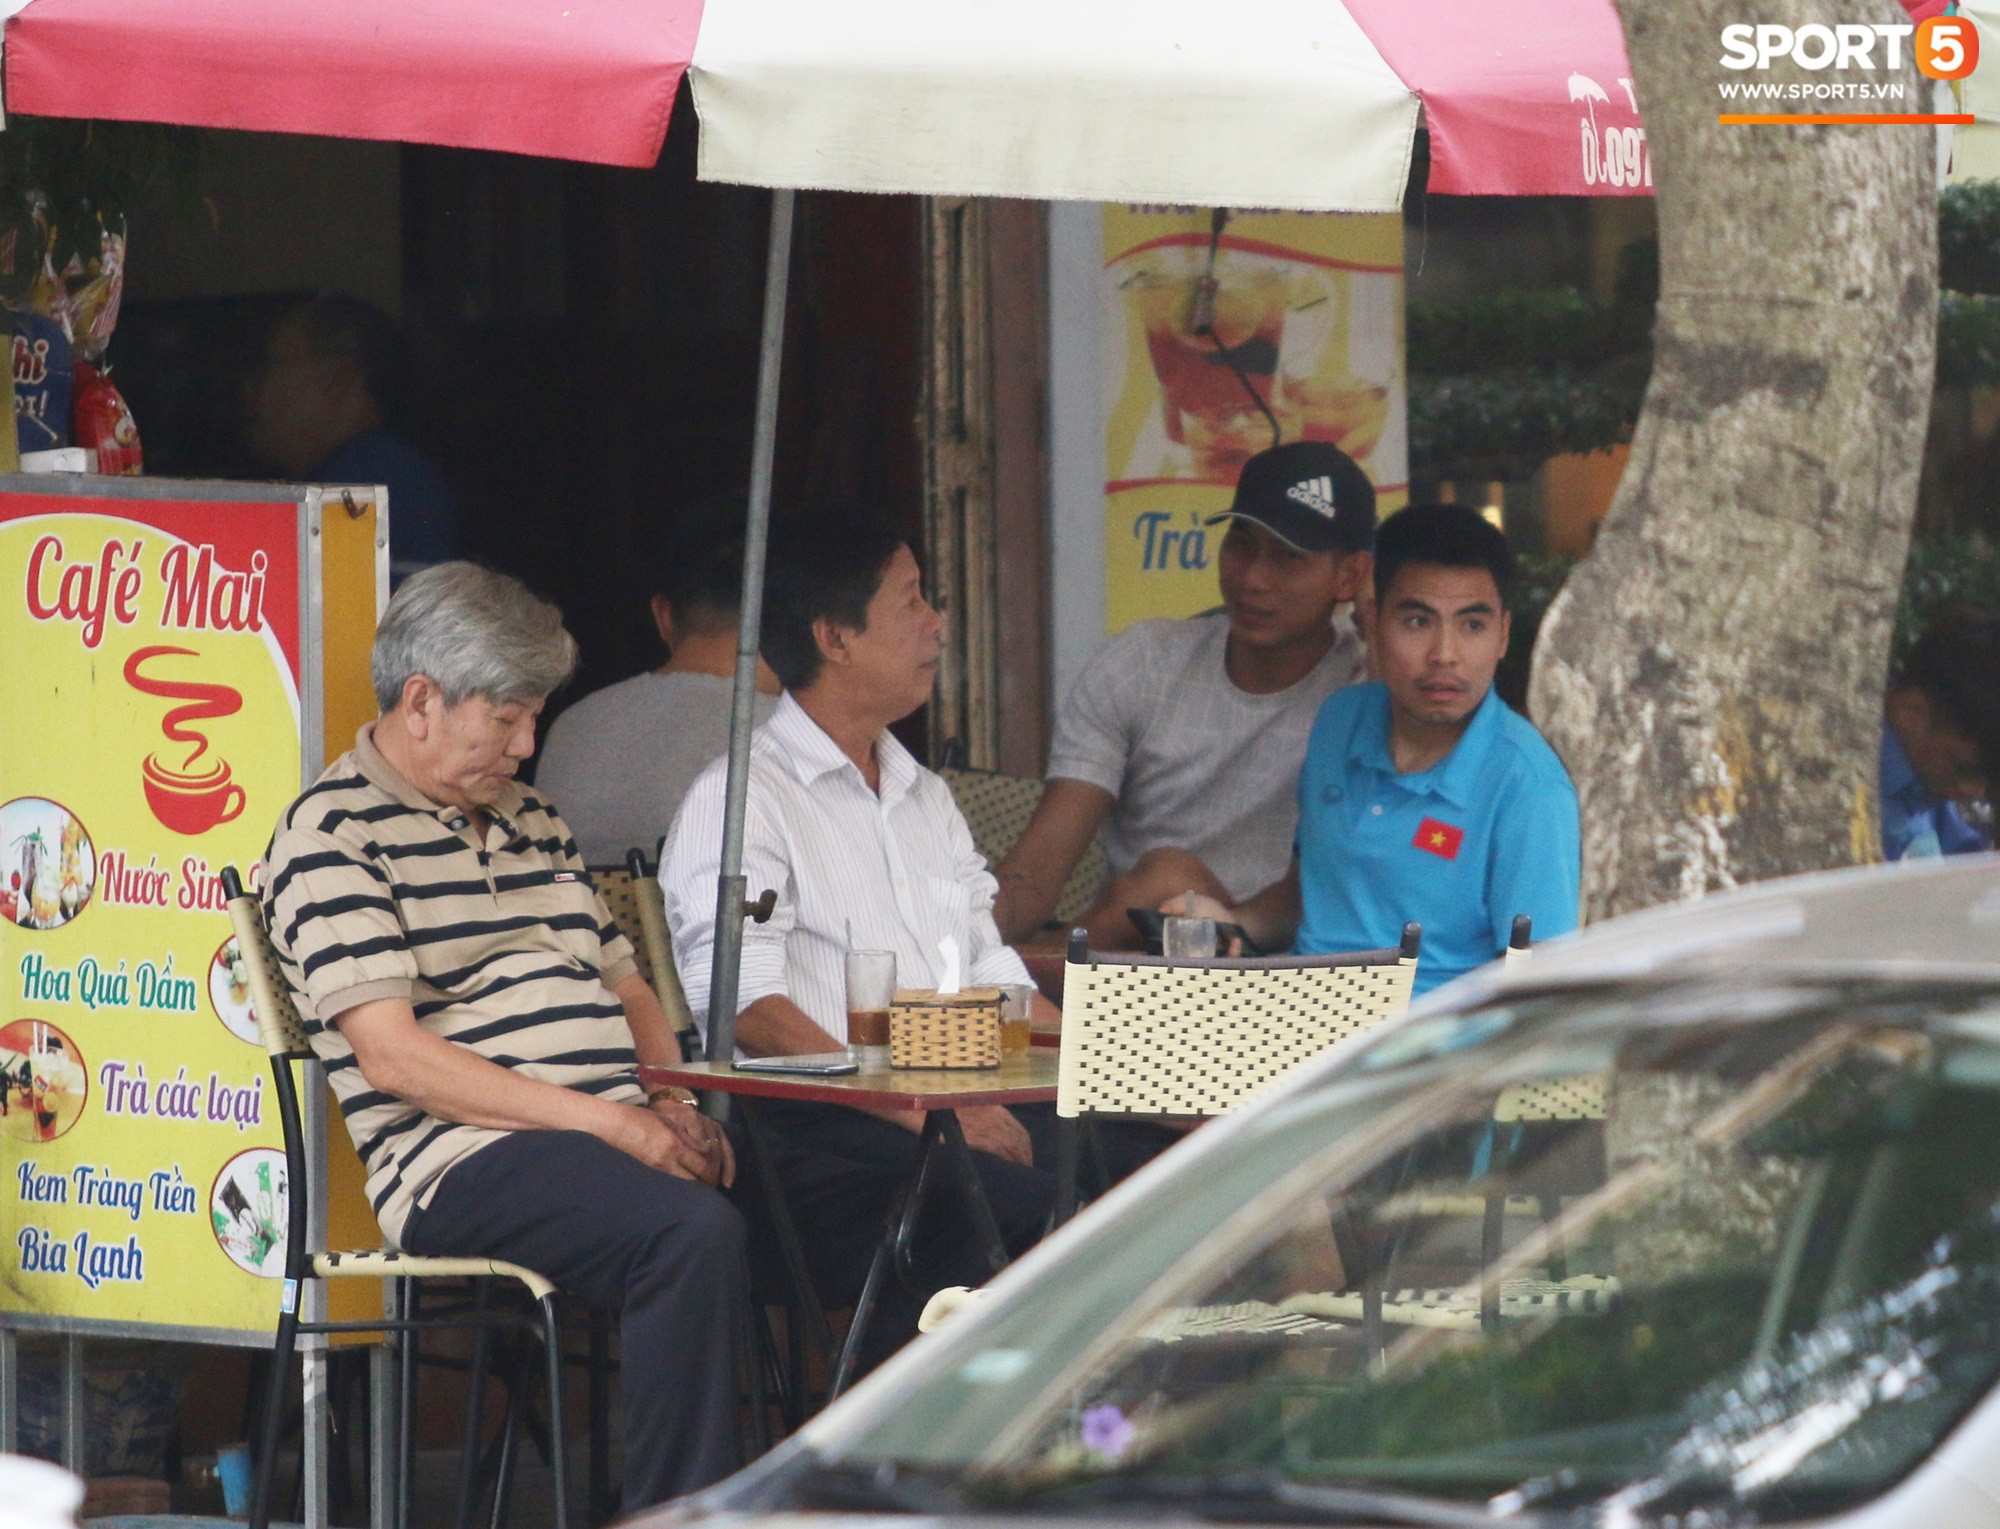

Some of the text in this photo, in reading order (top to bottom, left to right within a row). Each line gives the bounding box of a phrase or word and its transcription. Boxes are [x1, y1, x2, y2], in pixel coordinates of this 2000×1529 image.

[1134, 511, 1209, 570] Trà
[25, 535, 268, 649] Café Mai
[99, 851, 171, 907] Nước
[177, 857, 229, 912] Sin
[20, 954, 197, 1012] Hoa Quả Dầm
[100, 1062, 263, 1132] Trà các loại
[17, 1161, 196, 1221] Kem Tràng Tiền
[17, 1226, 143, 1290] Bia Lạnh
